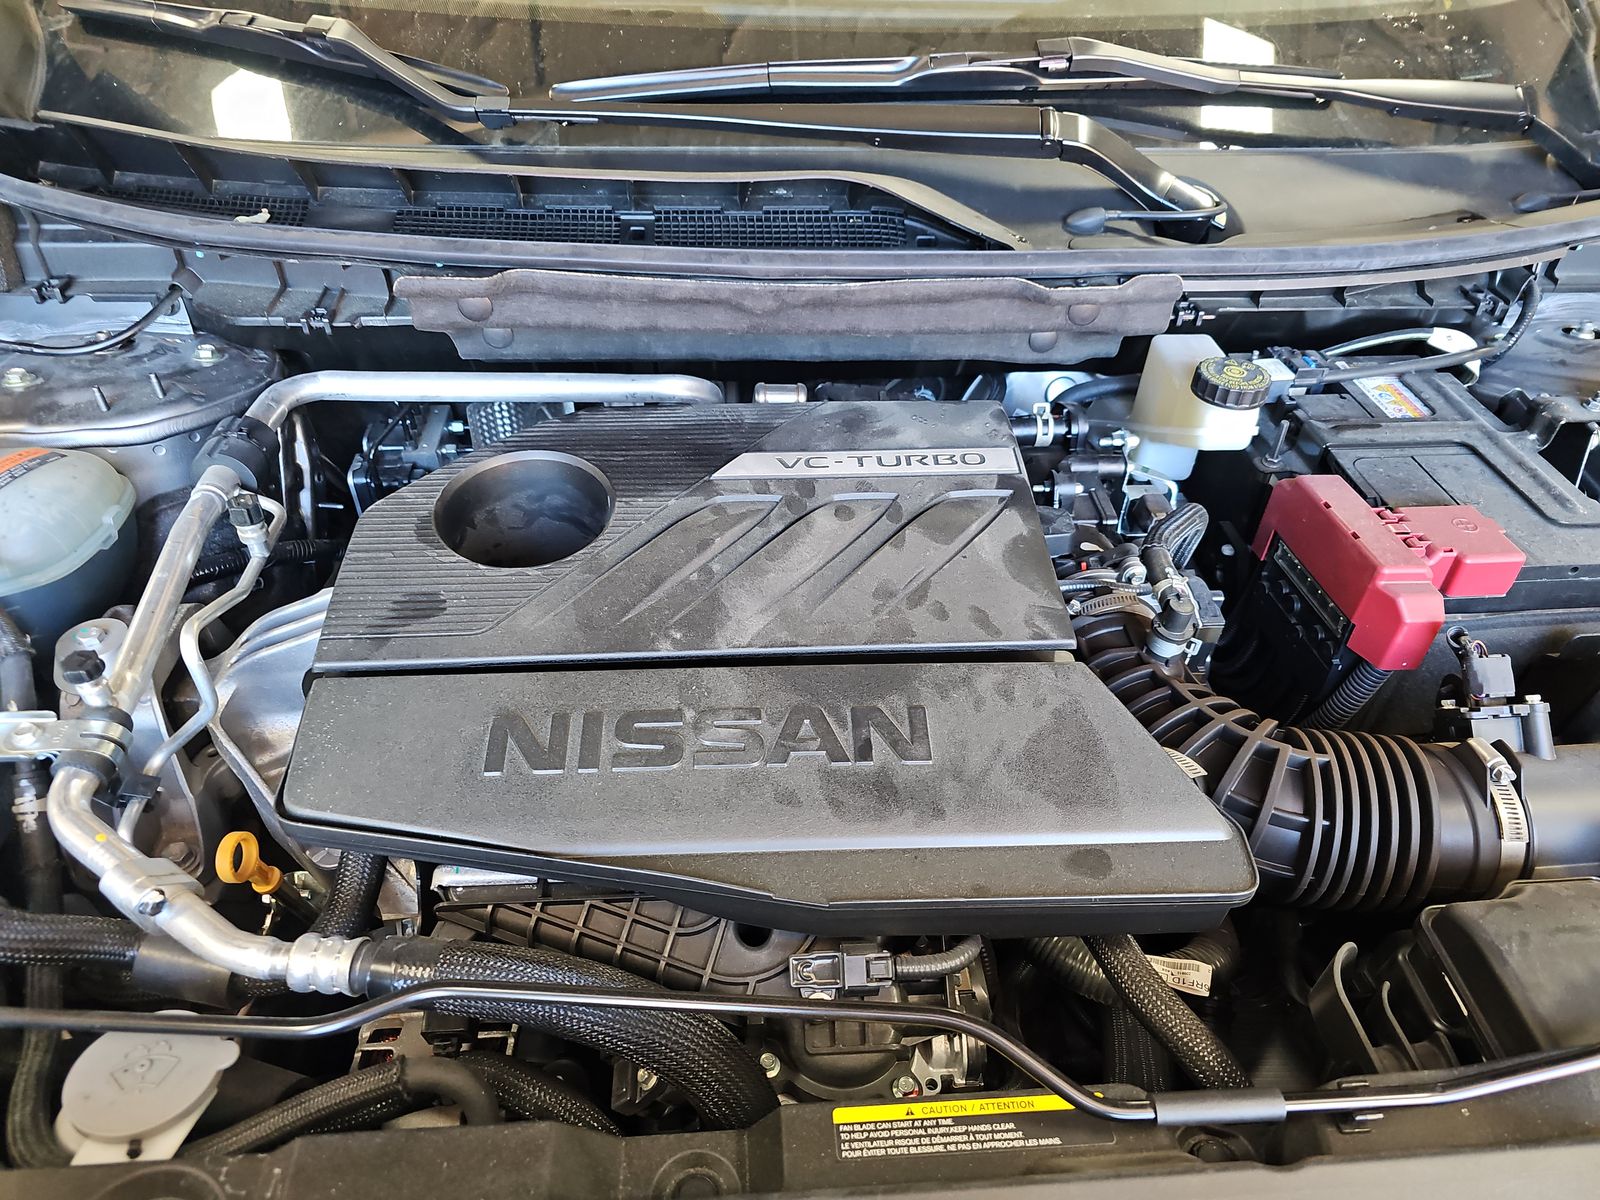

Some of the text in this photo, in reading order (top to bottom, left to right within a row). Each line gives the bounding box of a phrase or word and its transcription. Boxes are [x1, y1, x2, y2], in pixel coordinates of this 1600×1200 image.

[775, 452, 986, 470] VC-TURBO
[483, 705, 933, 777] NISSAN
[921, 1104, 967, 1115] CAUTION
[979, 1100, 1035, 1111] ATTENTION
[854, 1123, 876, 1131] BLADE
[876, 1122, 892, 1130] CAN
[892, 1120, 912, 1128] START
[869, 1130, 890, 1138] AVOID
[890, 1128, 926, 1136] PERSONAL
[968, 1124, 992, 1132] HANDS
[842, 1150, 862, 1158] POUR
[982, 1140, 1024, 1149] APPROCHER
[850, 1139, 894, 1149] VENTILATEUR
[894, 1138, 920, 1146] RISQUE
[932, 1134, 968, 1144] DÉMARRER
[975, 1132, 993, 1140] TOUT
